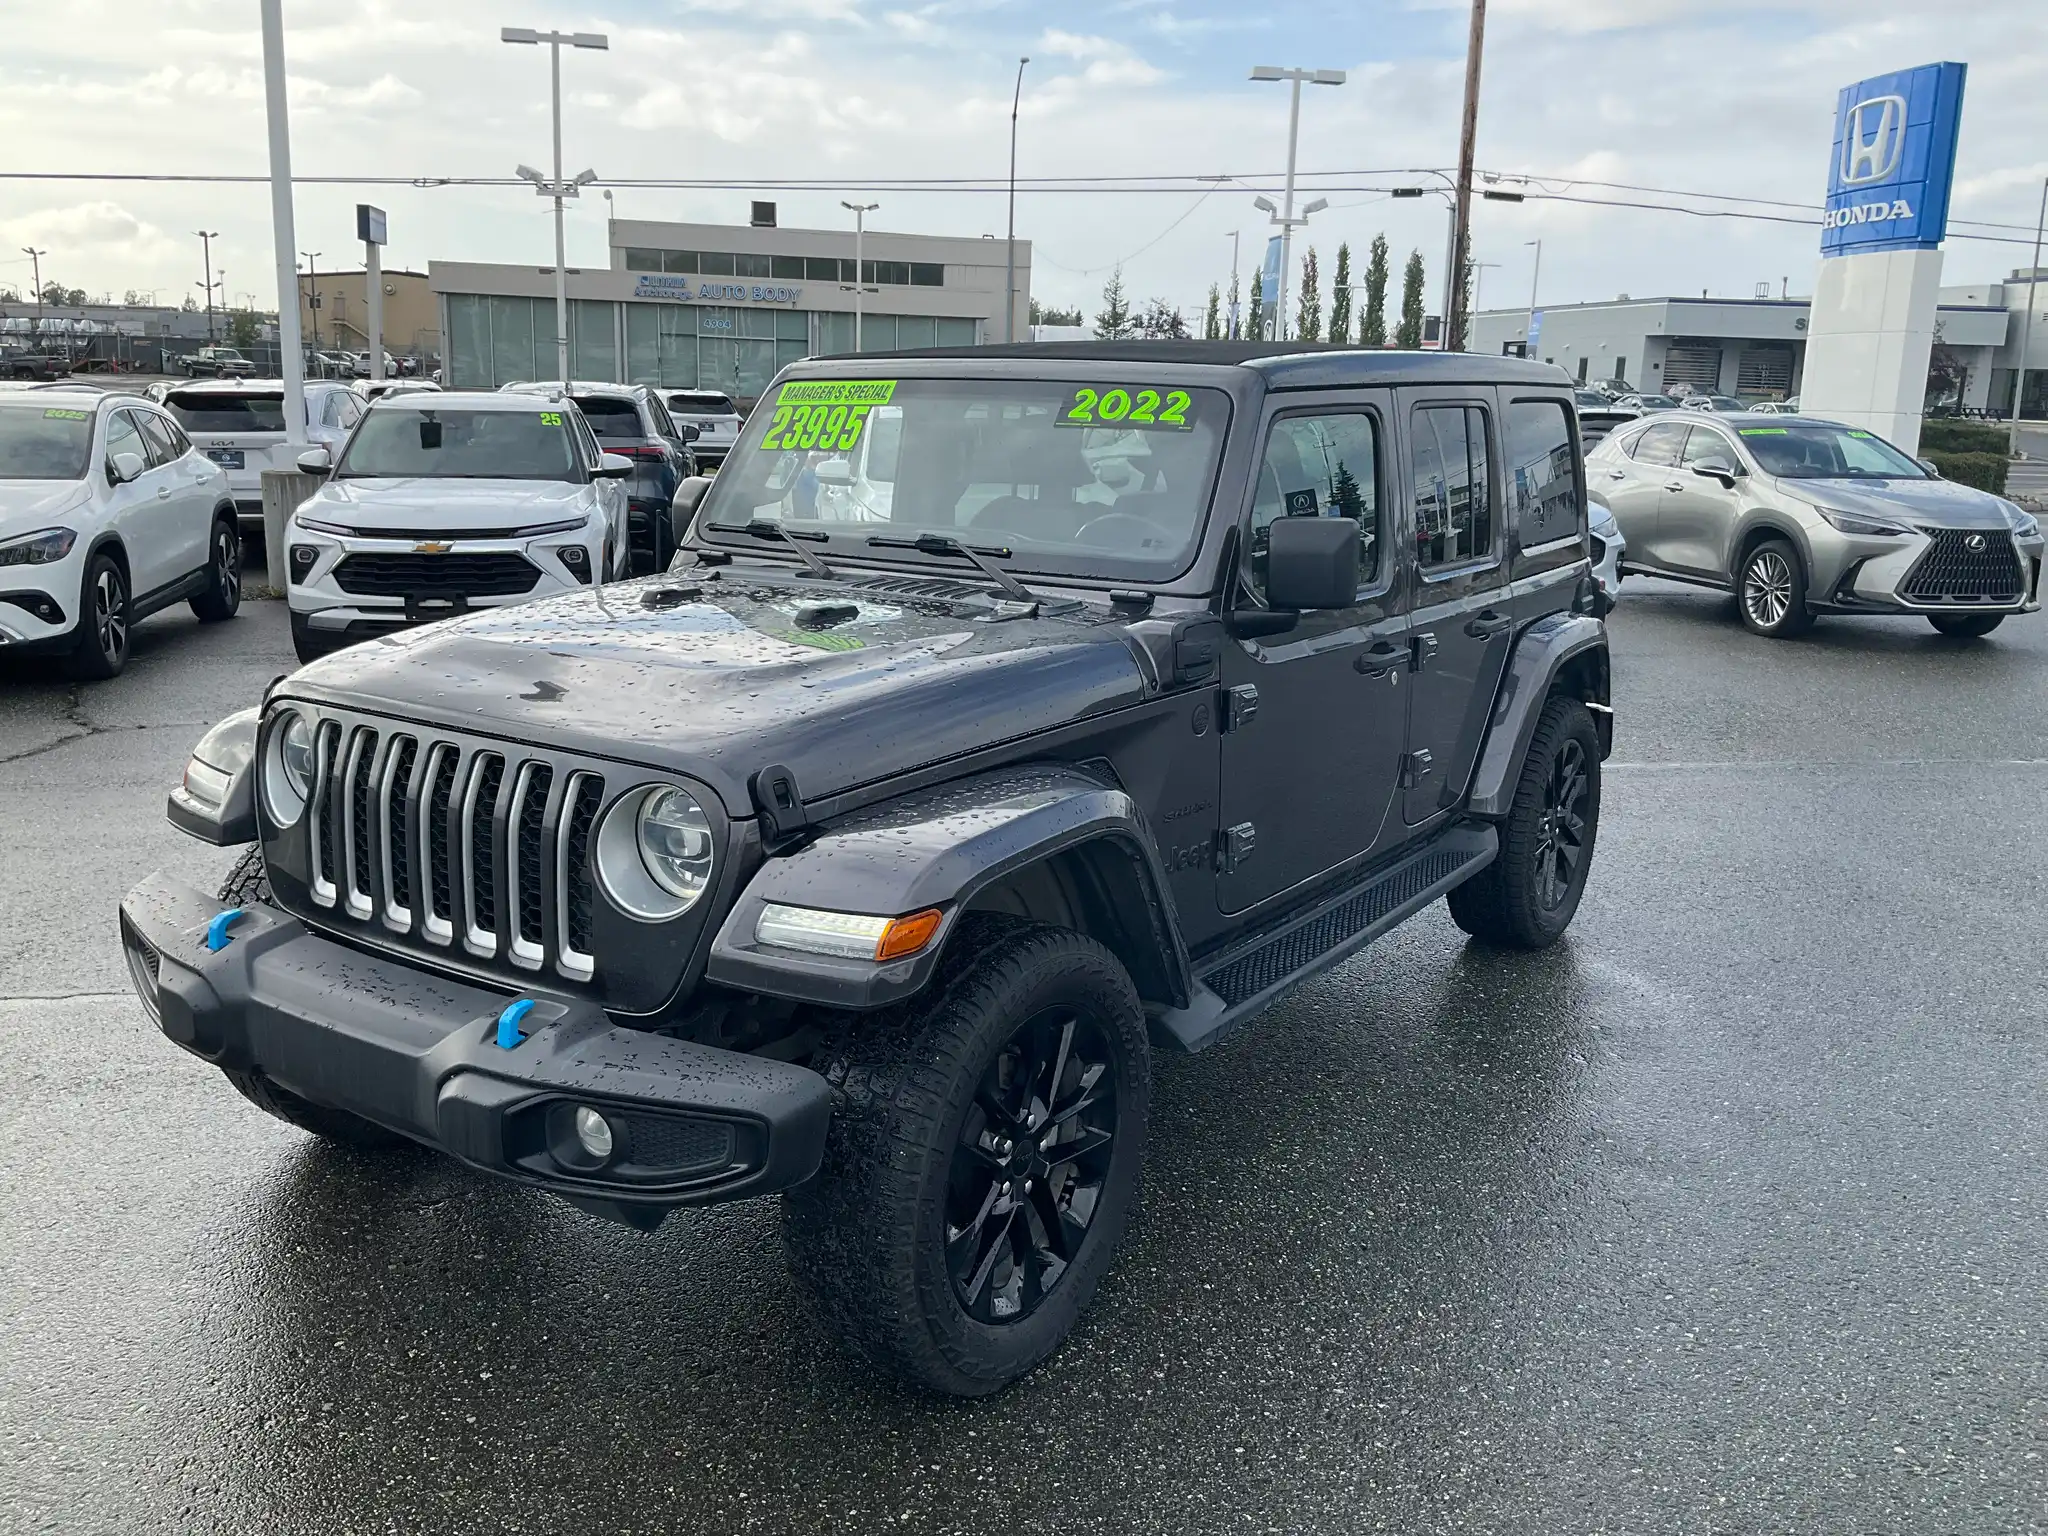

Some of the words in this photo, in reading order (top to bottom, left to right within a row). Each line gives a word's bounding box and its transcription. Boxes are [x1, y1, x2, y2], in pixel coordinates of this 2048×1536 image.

[1823, 199, 1914, 229] HONDA
[698, 284, 747, 301] AUTO
[752, 287, 803, 303] BODY
[703, 319, 732, 329] 4904
[782, 384, 846, 400] MANAGER'S
[844, 384, 893, 400] SPECIAL
[44, 409, 89, 420] 2025
[1068, 388, 1191, 425] 2022
[540, 412, 562, 426] 25
[760, 405, 870, 450] 23995
[1164, 840, 1211, 872] Jeep
